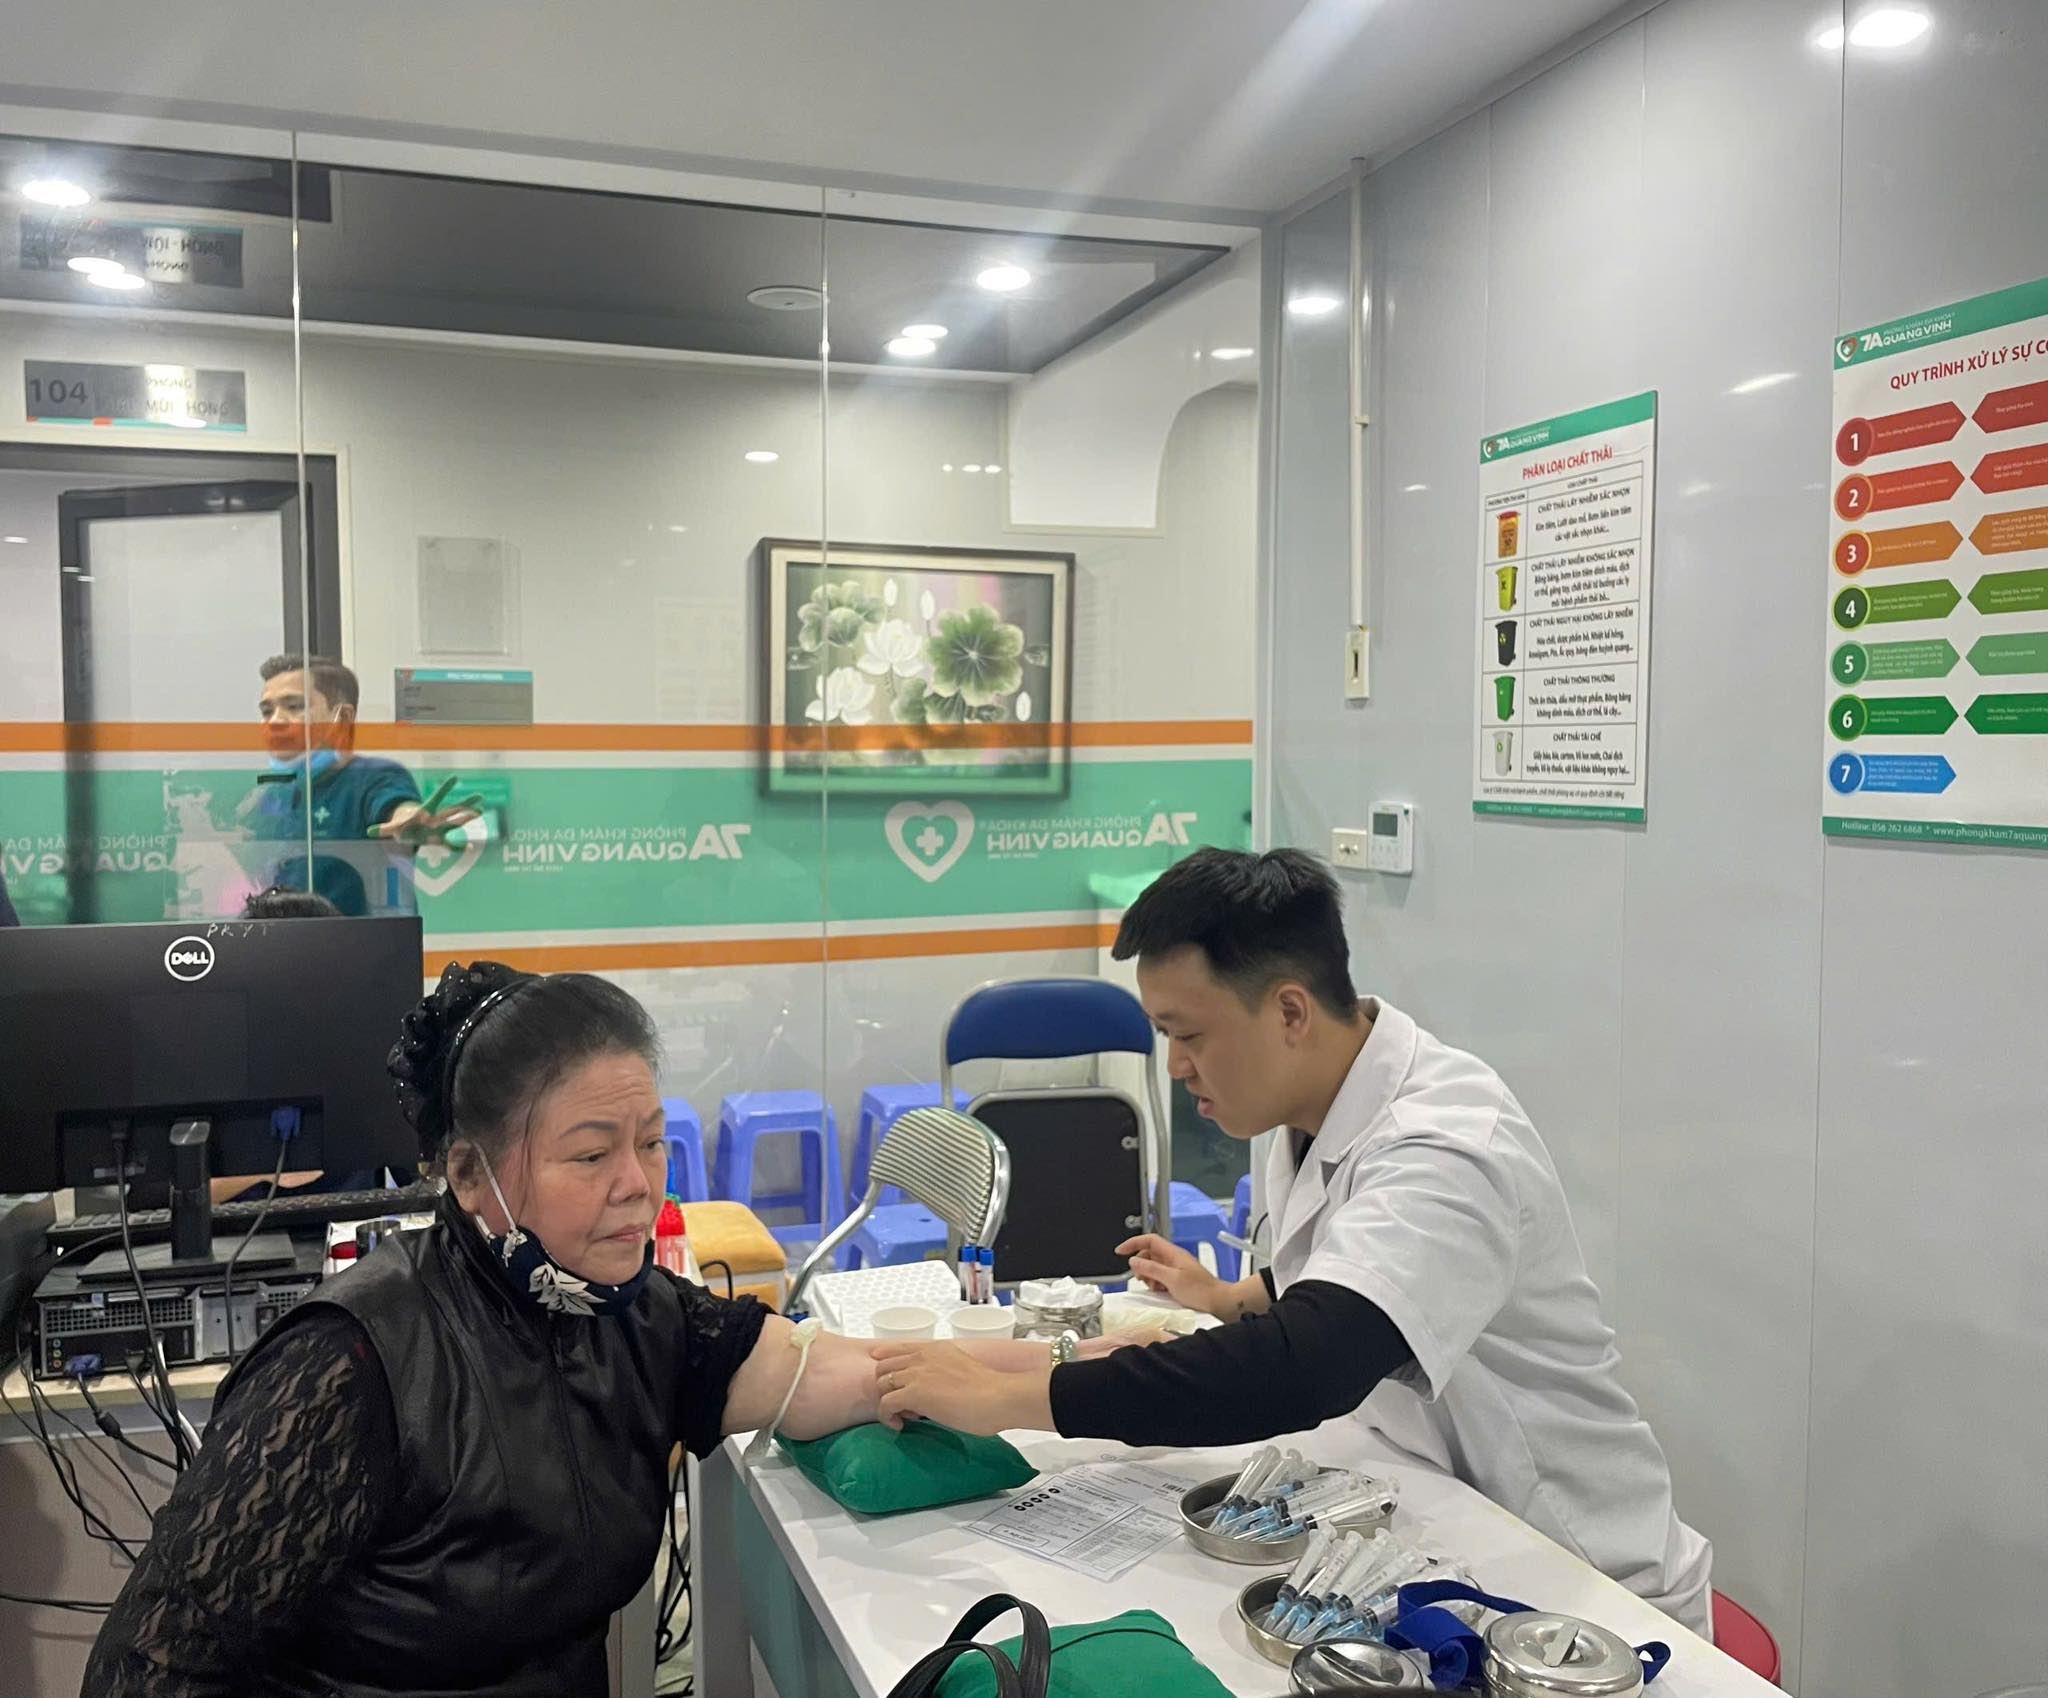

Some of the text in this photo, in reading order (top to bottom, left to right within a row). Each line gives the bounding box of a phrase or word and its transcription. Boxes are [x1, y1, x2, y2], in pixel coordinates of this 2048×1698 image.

[1860, 332, 1884, 352] 7A
[1923, 320, 1952, 335] VINH
[1890, 370, 1919, 390] QUY
[1922, 360, 1964, 381] TRÌNH
[1967, 349, 1990, 371] XỬ
[1992, 345, 2009, 365] LÝ
[2012, 340, 2033, 362] SỰ
[29, 379, 88, 403] 104
[1849, 432, 1859, 451] 1
[1522, 444, 1613, 480] PHÂN LOẠI CHẤT THẢI
[1848, 488, 1859, 508] 2
[1847, 545, 1857, 565] 3
[1844, 599, 1857, 618] 4
[1844, 655, 1854, 674] 5
[1842, 710, 1852, 729] 6
[1841, 765, 1851, 784] 7
[171, 951, 209, 965] DELL
